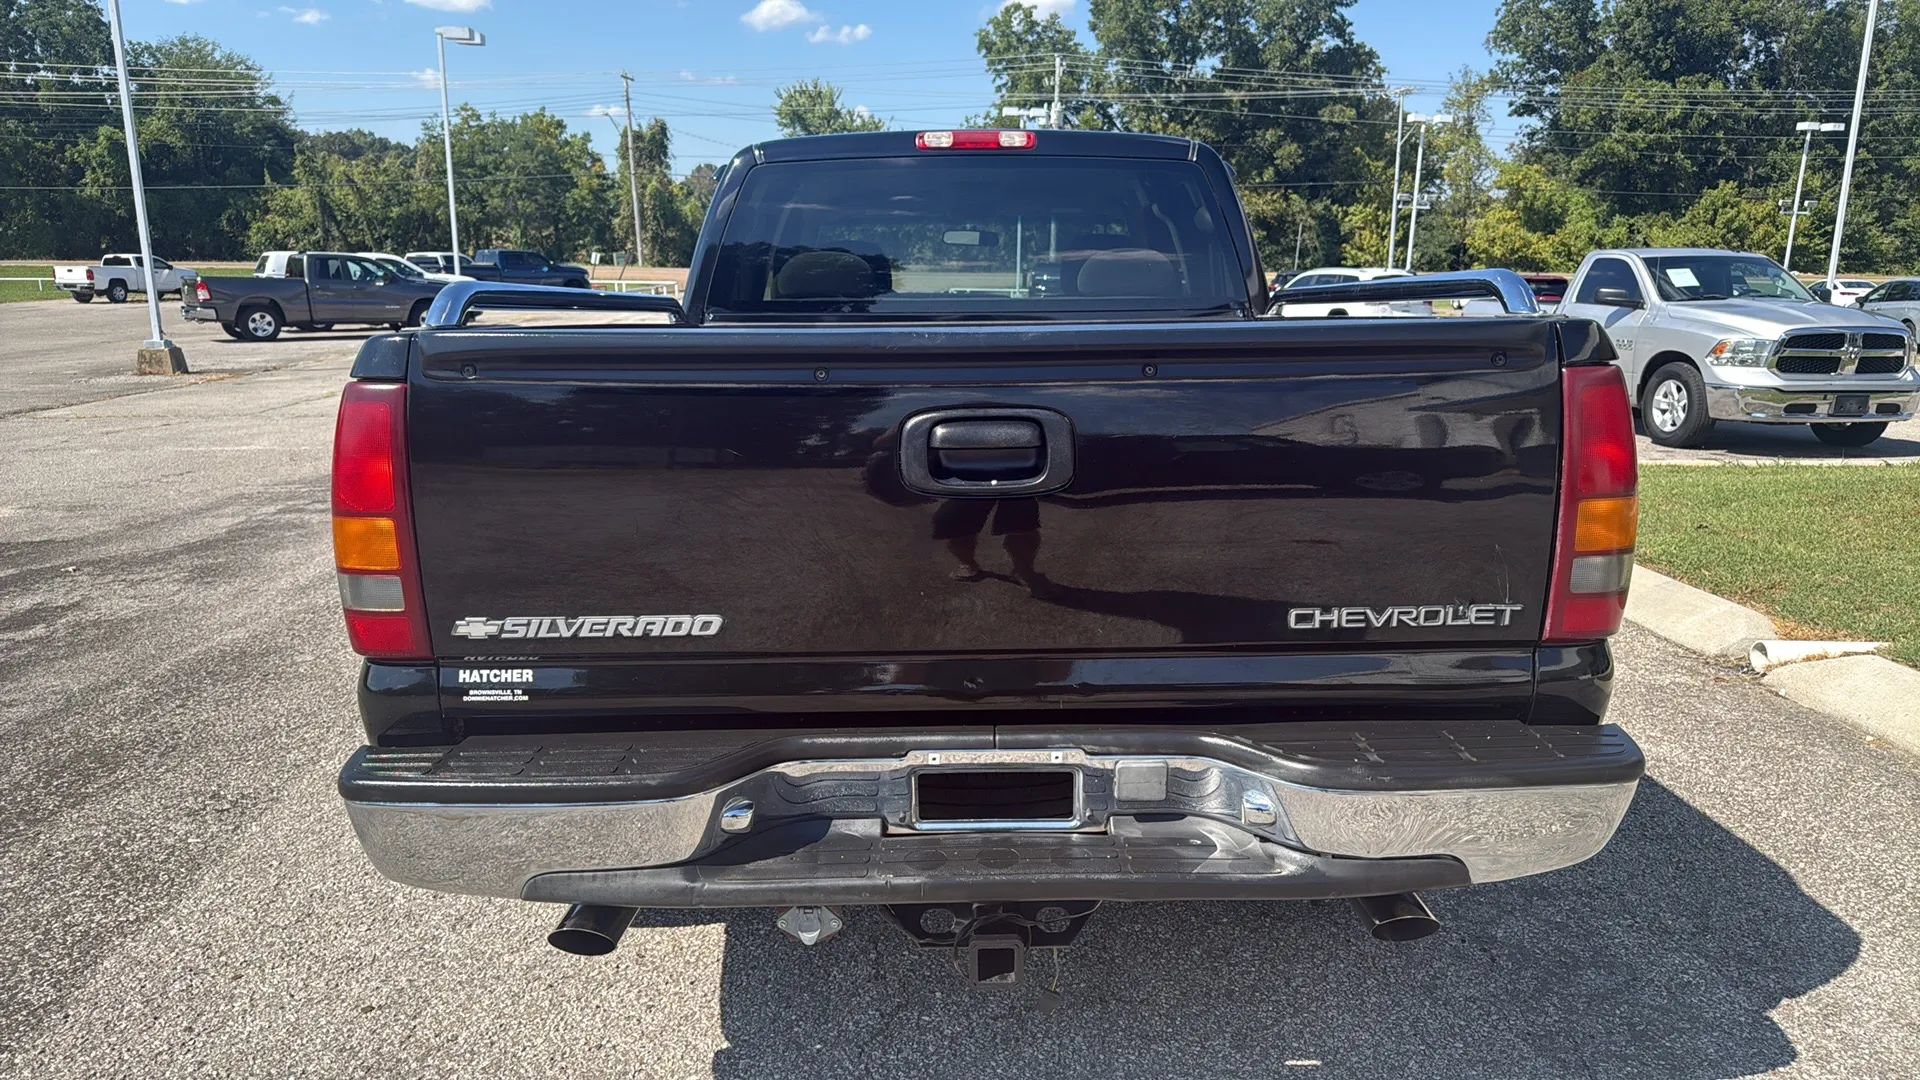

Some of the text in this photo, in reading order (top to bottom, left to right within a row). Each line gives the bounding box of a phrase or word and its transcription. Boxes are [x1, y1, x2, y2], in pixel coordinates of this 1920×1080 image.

[501, 614, 724, 638] SILVERADO
[1289, 603, 1524, 629] CHEVROLET
[458, 669, 534, 683] HATCHER
